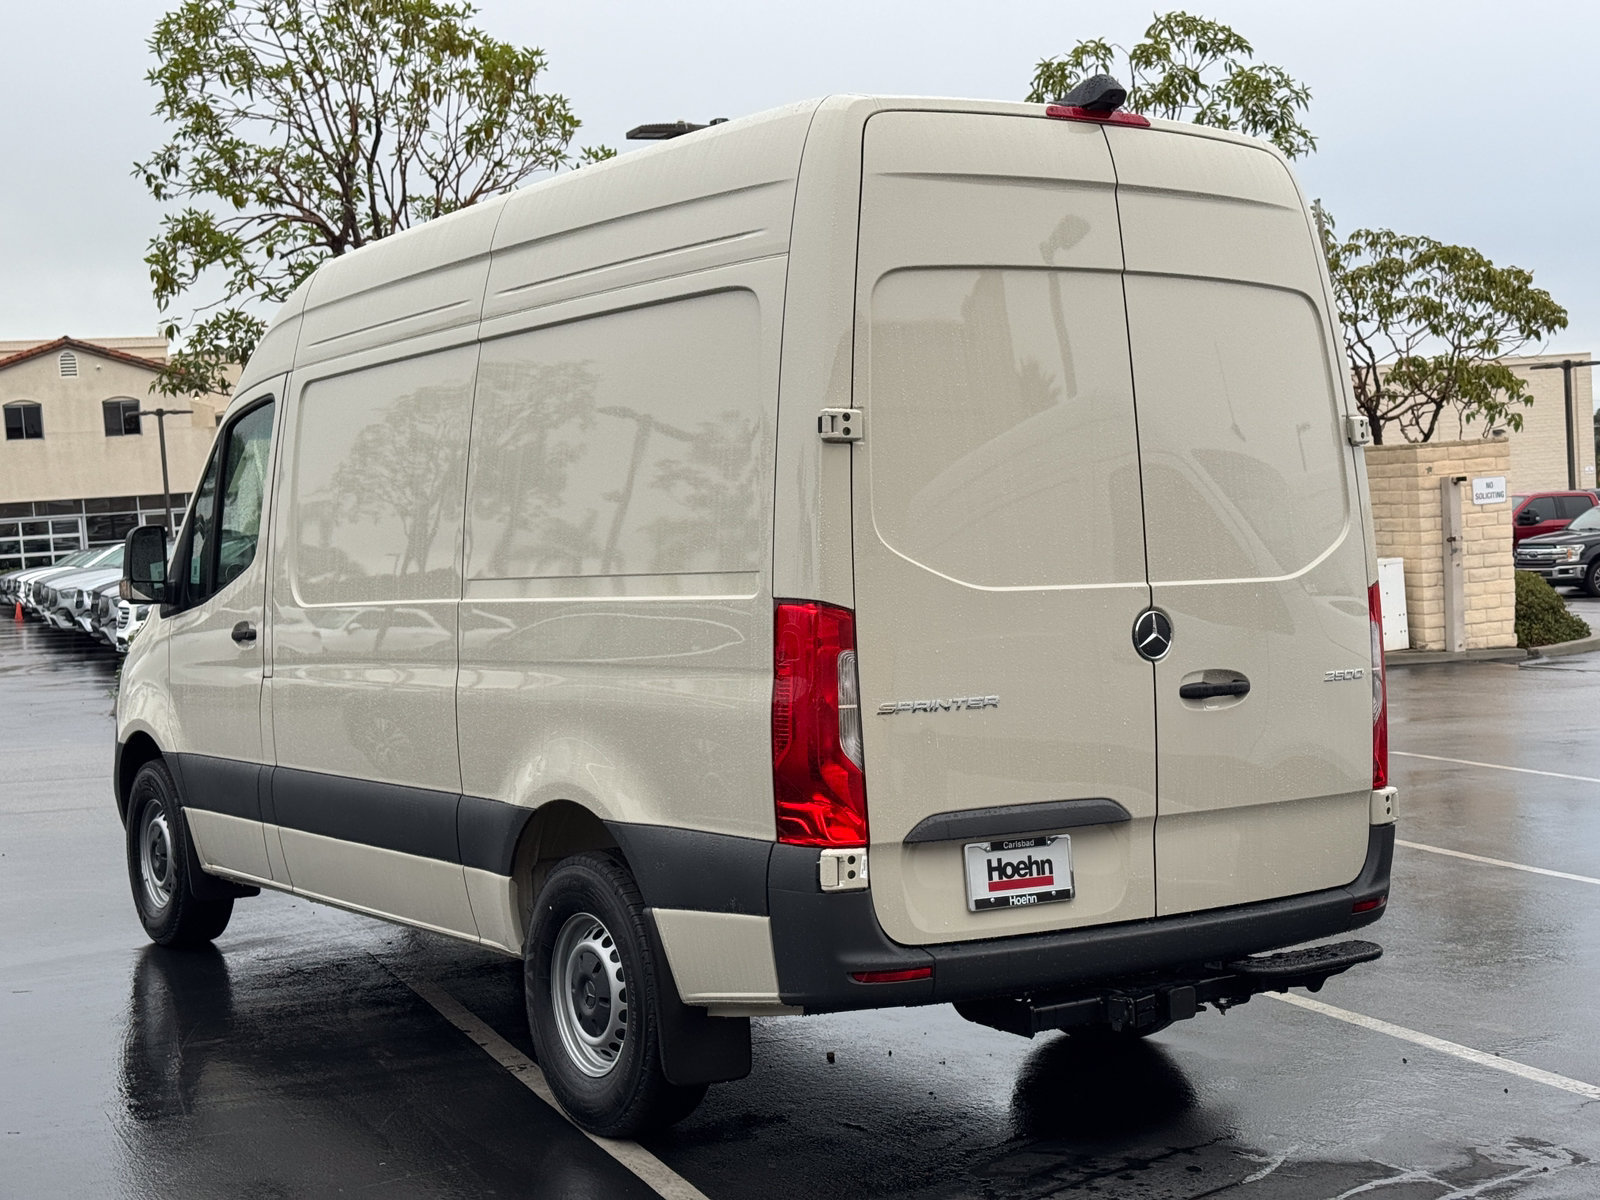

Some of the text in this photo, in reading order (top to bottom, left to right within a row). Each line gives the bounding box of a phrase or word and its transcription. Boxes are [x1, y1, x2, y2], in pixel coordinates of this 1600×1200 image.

[1475, 491, 1504, 500] SOLICITING
[877, 695, 1000, 715] SPRINTER
[1003, 839, 1035, 849] Carlsbad
[986, 855, 1054, 881] Hoehn
[1009, 894, 1038, 906] Hoehn
